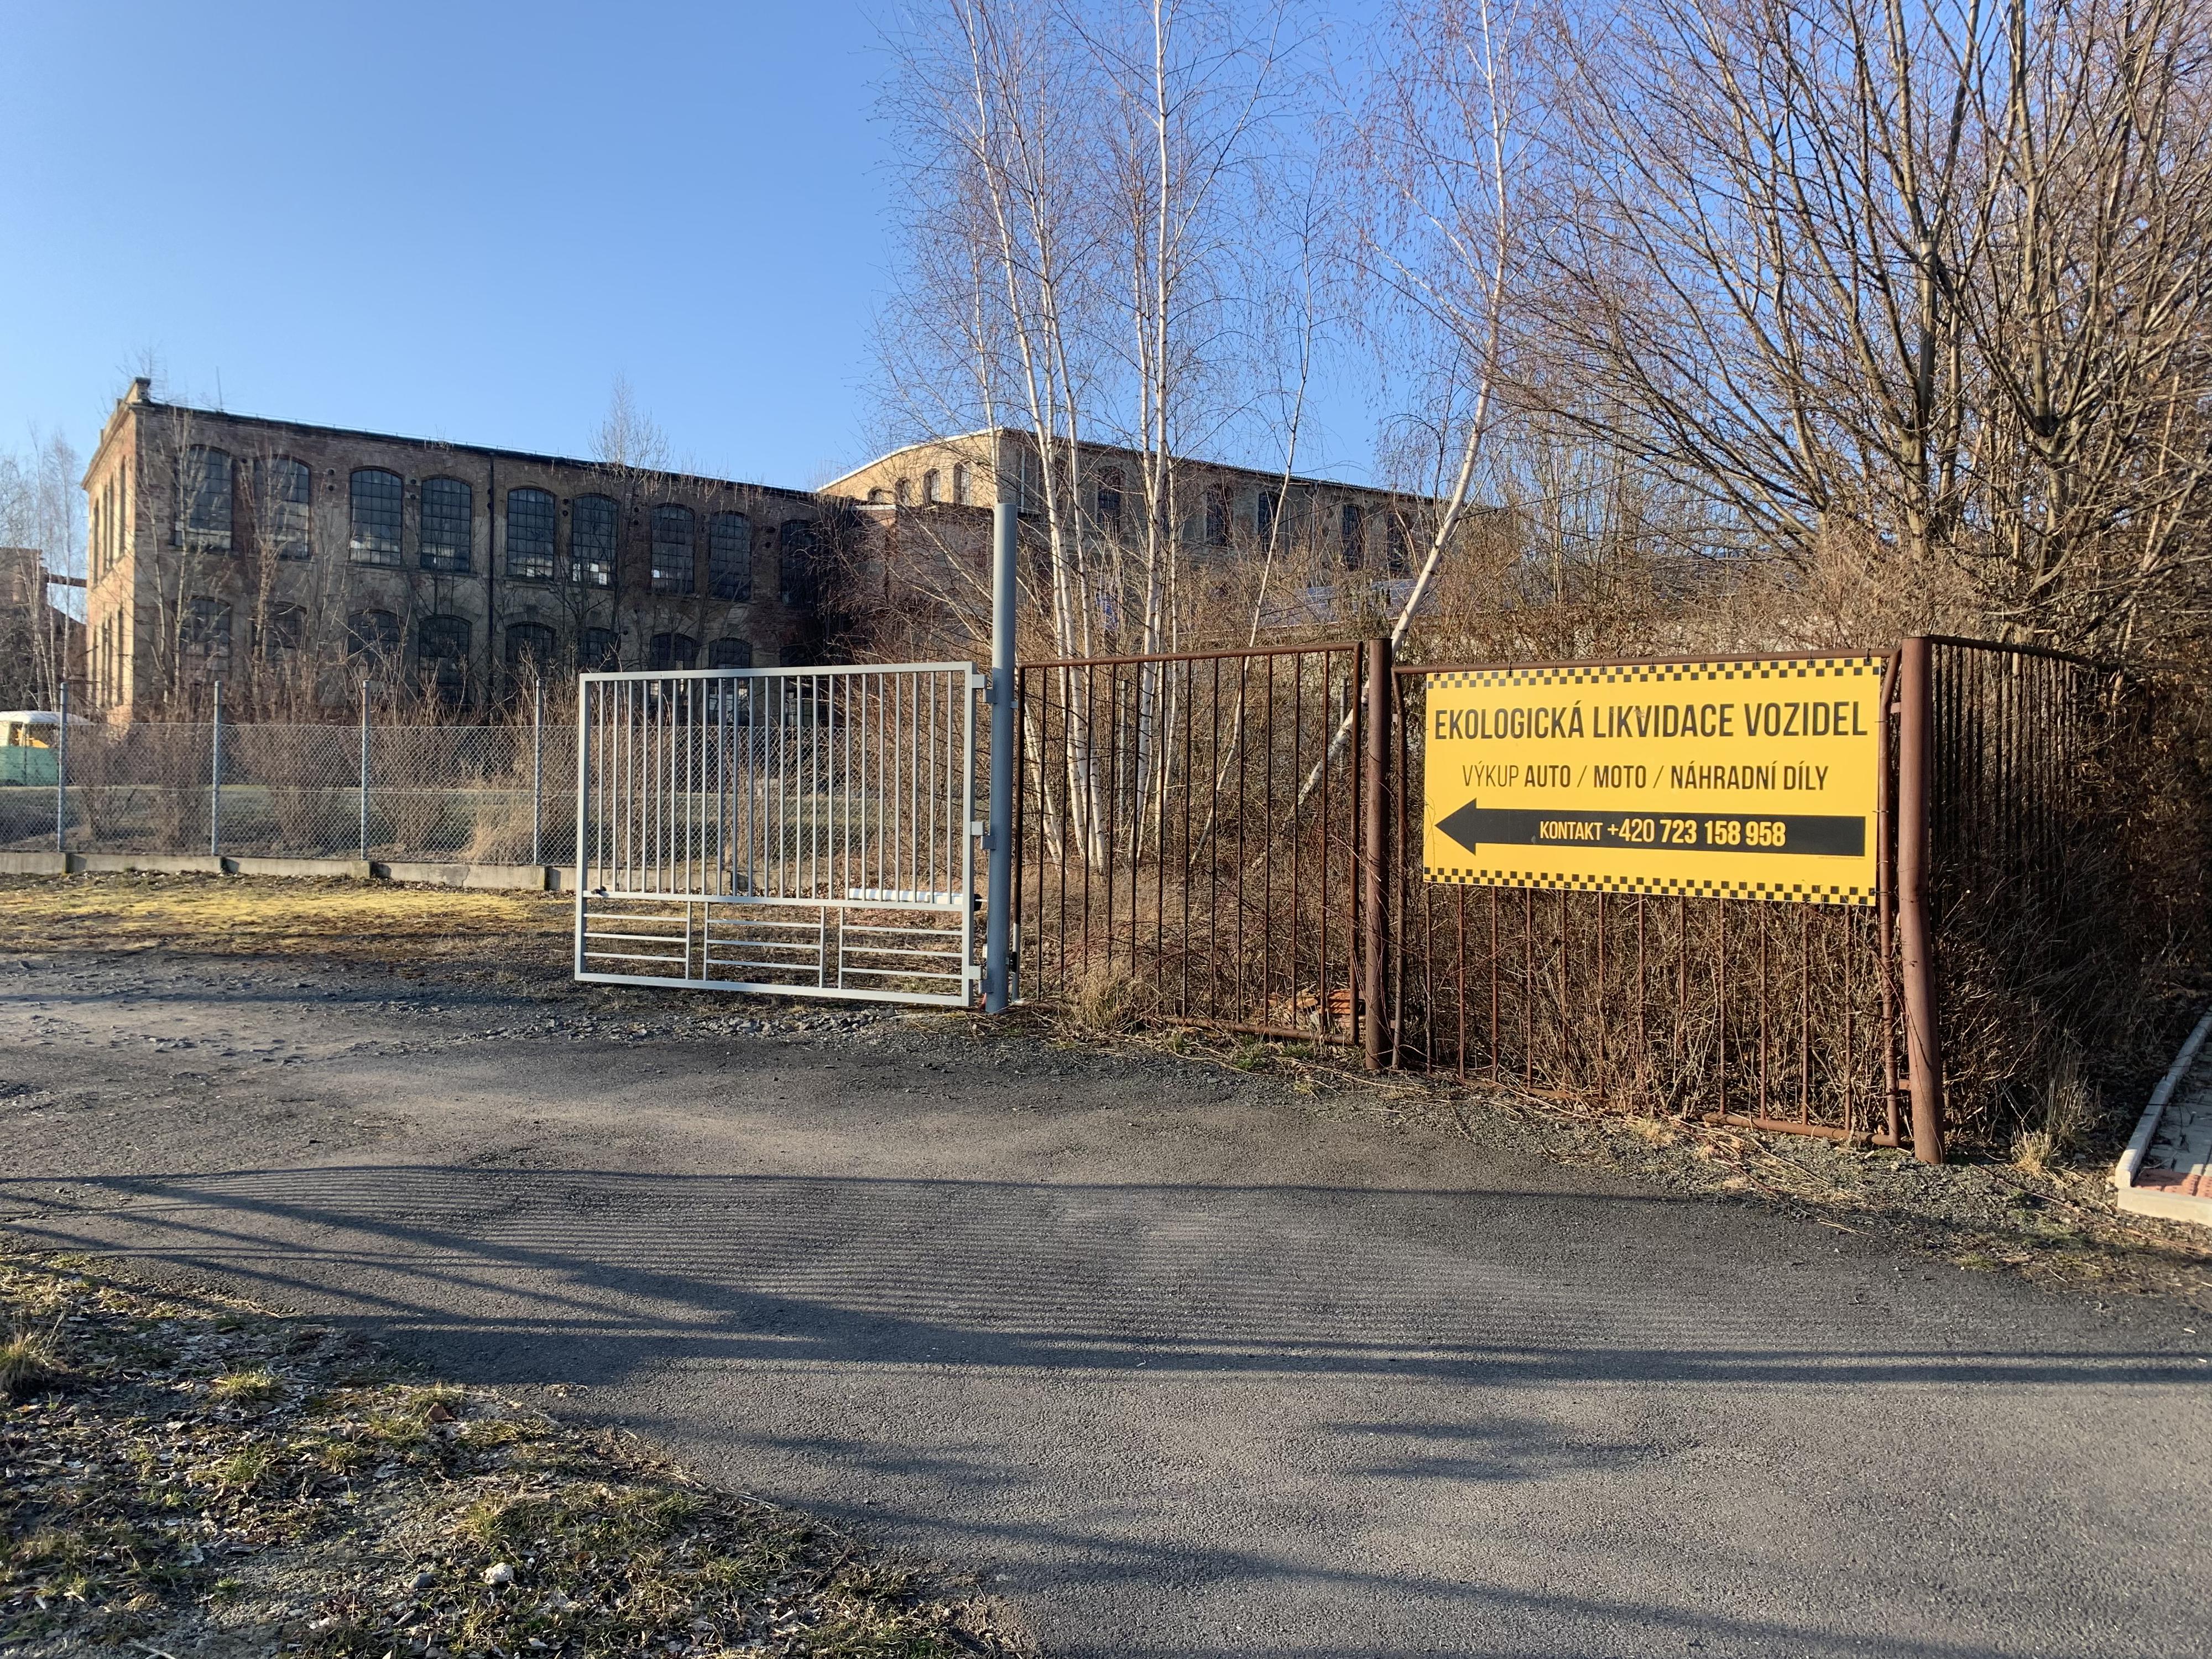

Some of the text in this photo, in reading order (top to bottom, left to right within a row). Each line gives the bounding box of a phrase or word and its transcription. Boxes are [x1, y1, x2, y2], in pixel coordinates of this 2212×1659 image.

[1435, 700, 1867, 740] EKOLOGICKÁ LIKVIDACE VOZIDEL
[1463, 760, 1828, 791] VÝKUP AUTO / MOTO / NÁHRADNÍ DÍLY
[1540, 818, 1786, 847] KONTAKT +420 723 158 958
